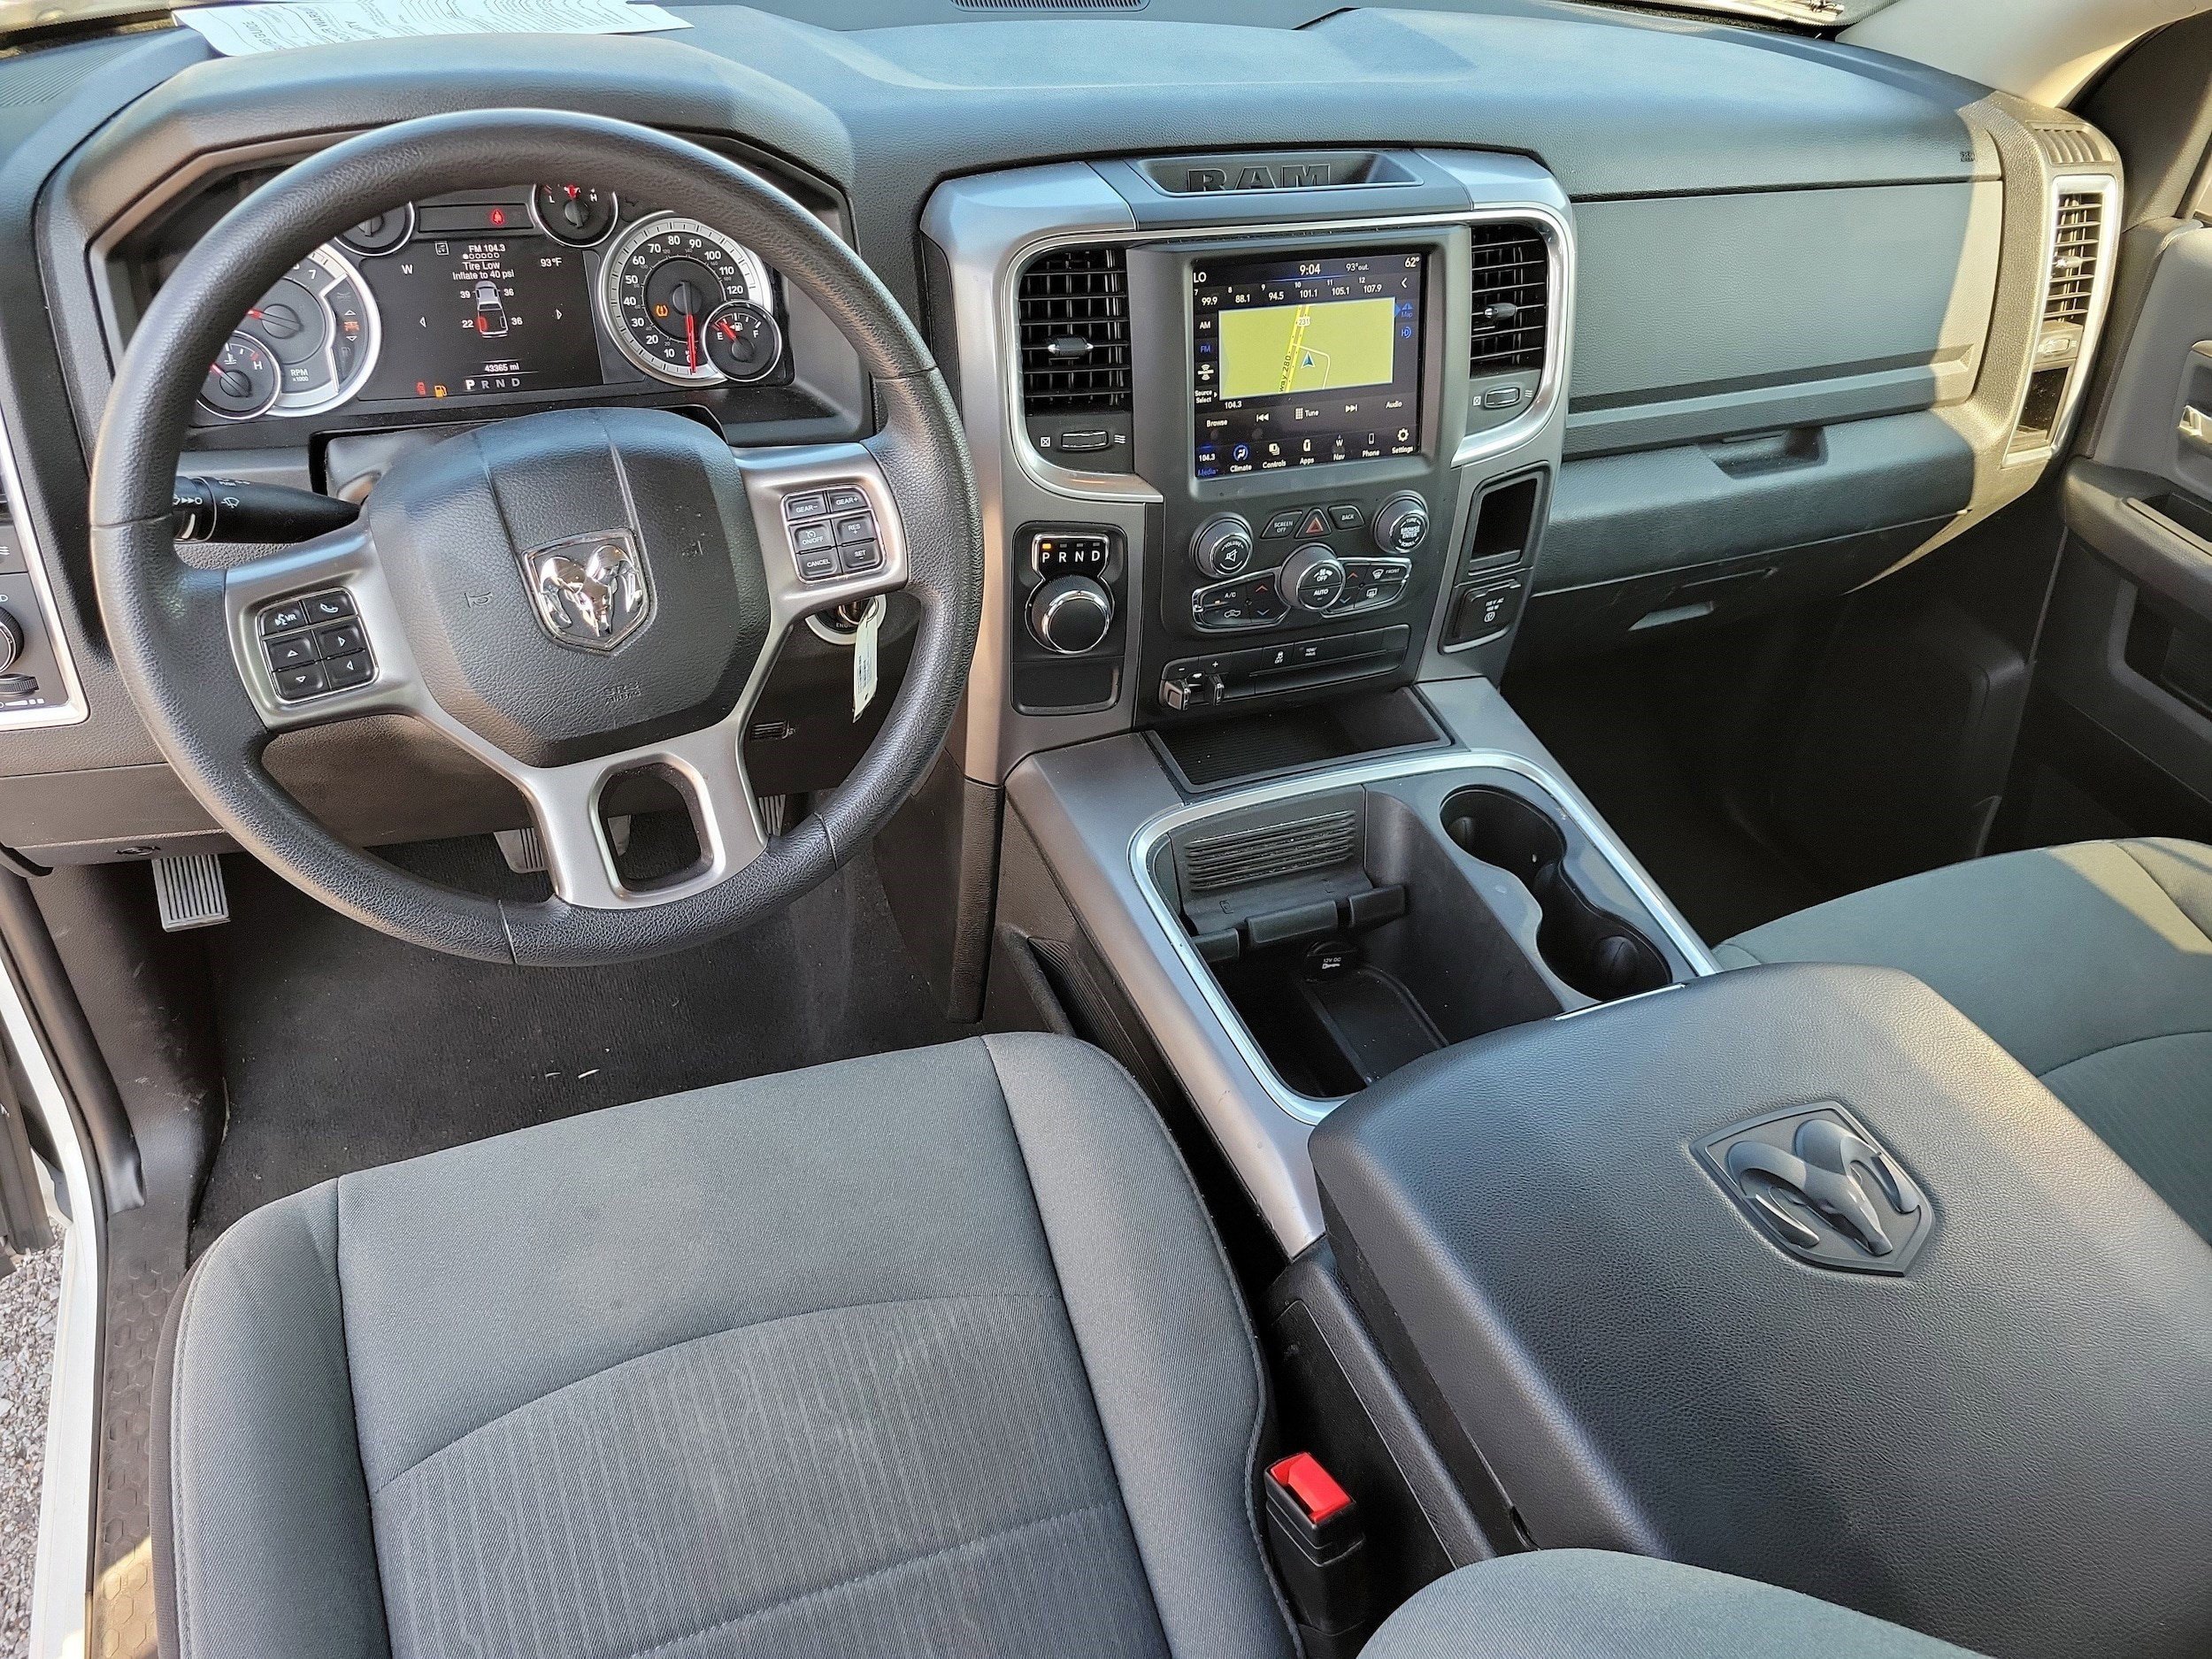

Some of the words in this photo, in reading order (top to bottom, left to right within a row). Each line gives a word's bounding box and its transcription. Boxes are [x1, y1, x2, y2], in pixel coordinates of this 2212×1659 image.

[1187, 163, 1331, 192] RAM
[549, 195, 555, 204] L
[590, 193, 598, 203] H
[668, 234, 680, 245] 80
[689, 239, 703, 249] 90
[468, 244, 482, 253] FM
[485, 243, 506, 253] 104.3
[647, 243, 661, 253] 70
[704, 250, 721, 261] 100
[632, 256, 646, 265] 60
[1404, 257, 1420, 268] 62°
[401, 264, 413, 275] W
[463, 261, 484, 271] Tire
[486, 261, 501, 270] Low
[719, 266, 734, 275] 110
[1299, 264, 1321, 276] 9:04
[309, 269, 317, 280] 7
[452, 272, 478, 280] Inflate
[489, 271, 501, 280] 40
[502, 270, 515, 280] psi
[1193, 272, 1207, 283] LO
[625, 275, 639, 284] 50
[460, 290, 471, 299] 39
[503, 288, 514, 297] 36
[726, 285, 744, 295] 120
[1202, 296, 1217, 306] 99.9
[1235, 294, 1250, 303] 88.1
[1268, 291, 1284, 301] 94.5
[1299, 289, 1318, 299] 101.1
[1332, 287, 1350, 296] 105.1
[1363, 284, 1382, 294] 107.9
[623, 296, 637, 306] 40
[462, 319, 474, 328] 22
[511, 317, 523, 326] 36
[631, 318, 645, 327] 30
[1199, 321, 1211, 330] AM
[646, 334, 659, 345] 20
[717, 332, 723, 341] E
[664, 348, 675, 357] 10
[1201, 344, 1211, 353] FM
[254, 361, 263, 370] H
[1283, 355, 1292, 373] 280
[465, 380, 475, 390] P
[481, 380, 490, 388] R
[495, 378, 505, 388] N
[511, 378, 520, 388] D
[1194, 389, 1212, 398] Source
[1225, 401, 1242, 410] 104.3
[1386, 400, 1402, 409] Audio
[1206, 419, 1228, 427] Browse
[1362, 448, 1380, 457] Phone
[1391, 444, 1414, 455] Settings
[1198, 453, 1216, 462] 104.3
[1300, 457, 1315, 465] Apps
[1230, 464, 1252, 473] Climate
[1263, 459, 1286, 469] Controls
[1198, 467, 1217, 477] Media
[1274, 520, 1294, 529] SCREEN
[1401, 526, 1420, 534] BROWSE
[802, 536, 824, 545] ON/OFF
[1042, 552, 1050, 564] P
[1058, 551, 1067, 563] R
[1075, 550, 1085, 563] N
[1091, 550, 1101, 562] D
[806, 558, 831, 567] CANCEL
[1386, 566, 1401, 575] FRONT
